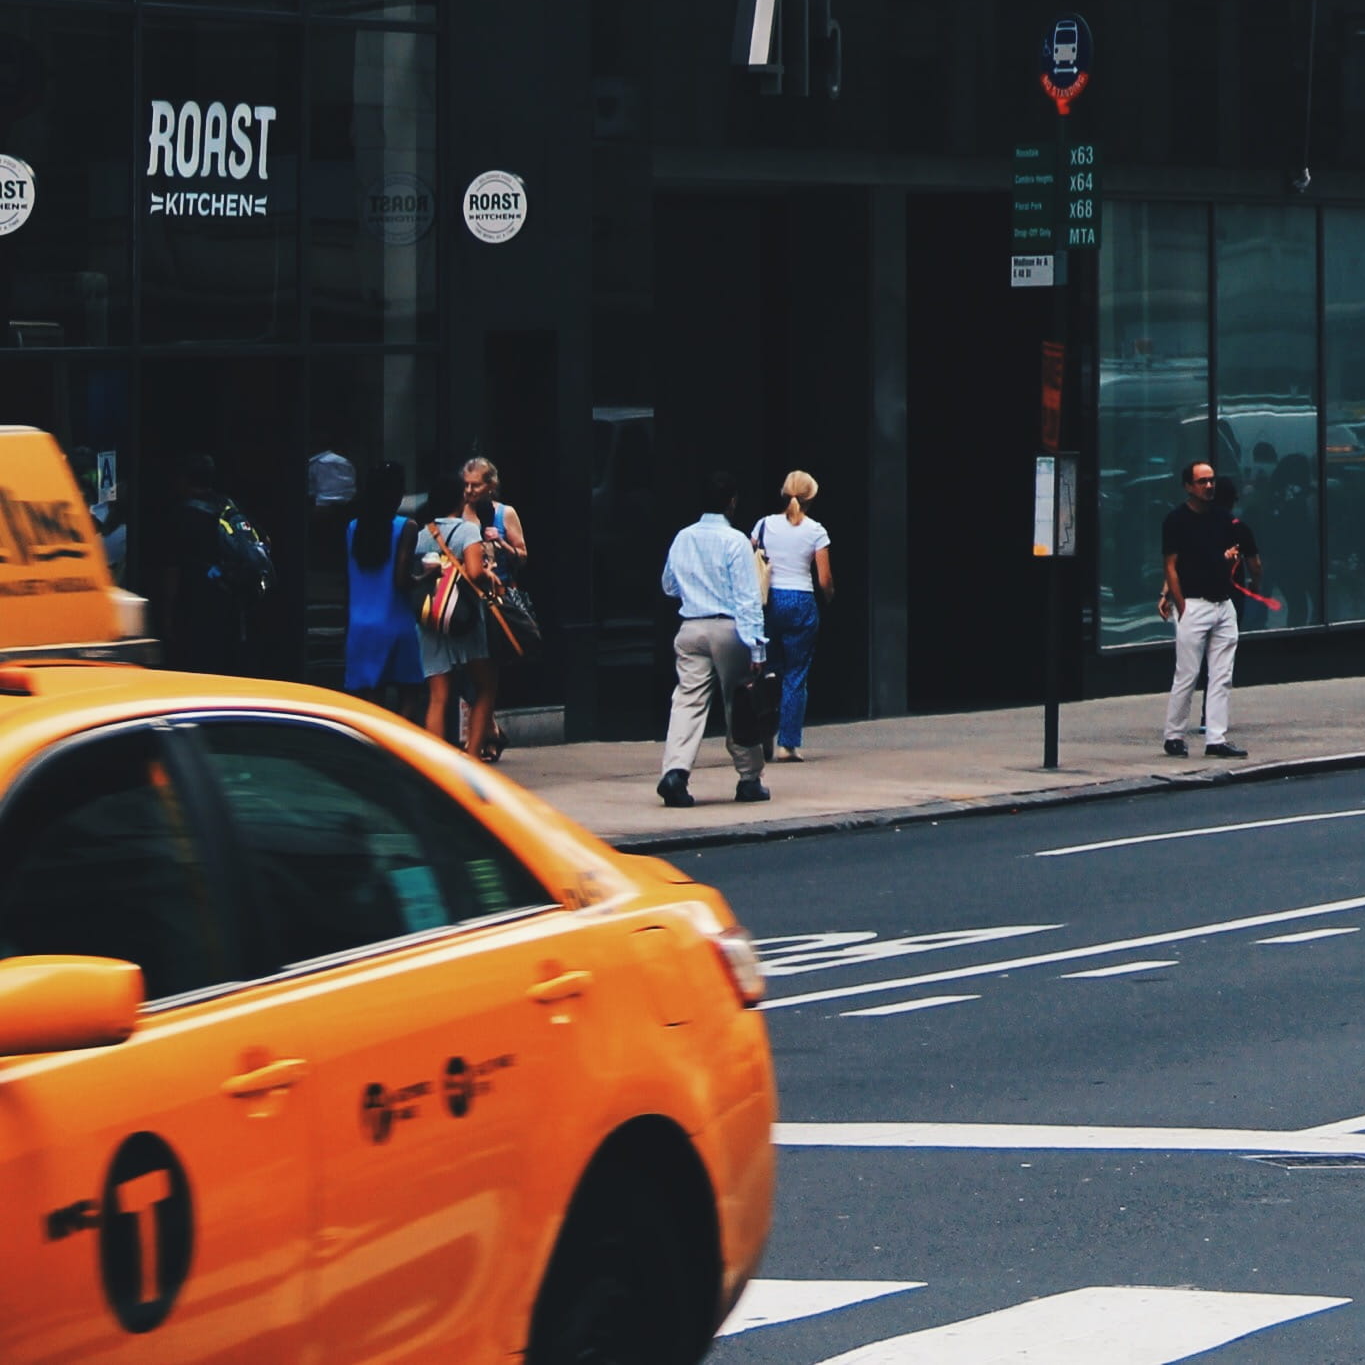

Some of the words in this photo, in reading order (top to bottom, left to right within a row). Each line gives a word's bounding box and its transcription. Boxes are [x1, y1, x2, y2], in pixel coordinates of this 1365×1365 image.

[147, 100, 277, 180] ROAST
[1070, 145, 1094, 165] x63
[1070, 172, 1093, 192] x64
[165, 192, 253, 217] KITCHEN
[469, 193, 521, 211] ROAST
[1069, 199, 1093, 218] x68
[475, 213, 515, 221] KITCHEN
[1069, 228, 1095, 244] MTA
[100, 457, 114, 489] A
